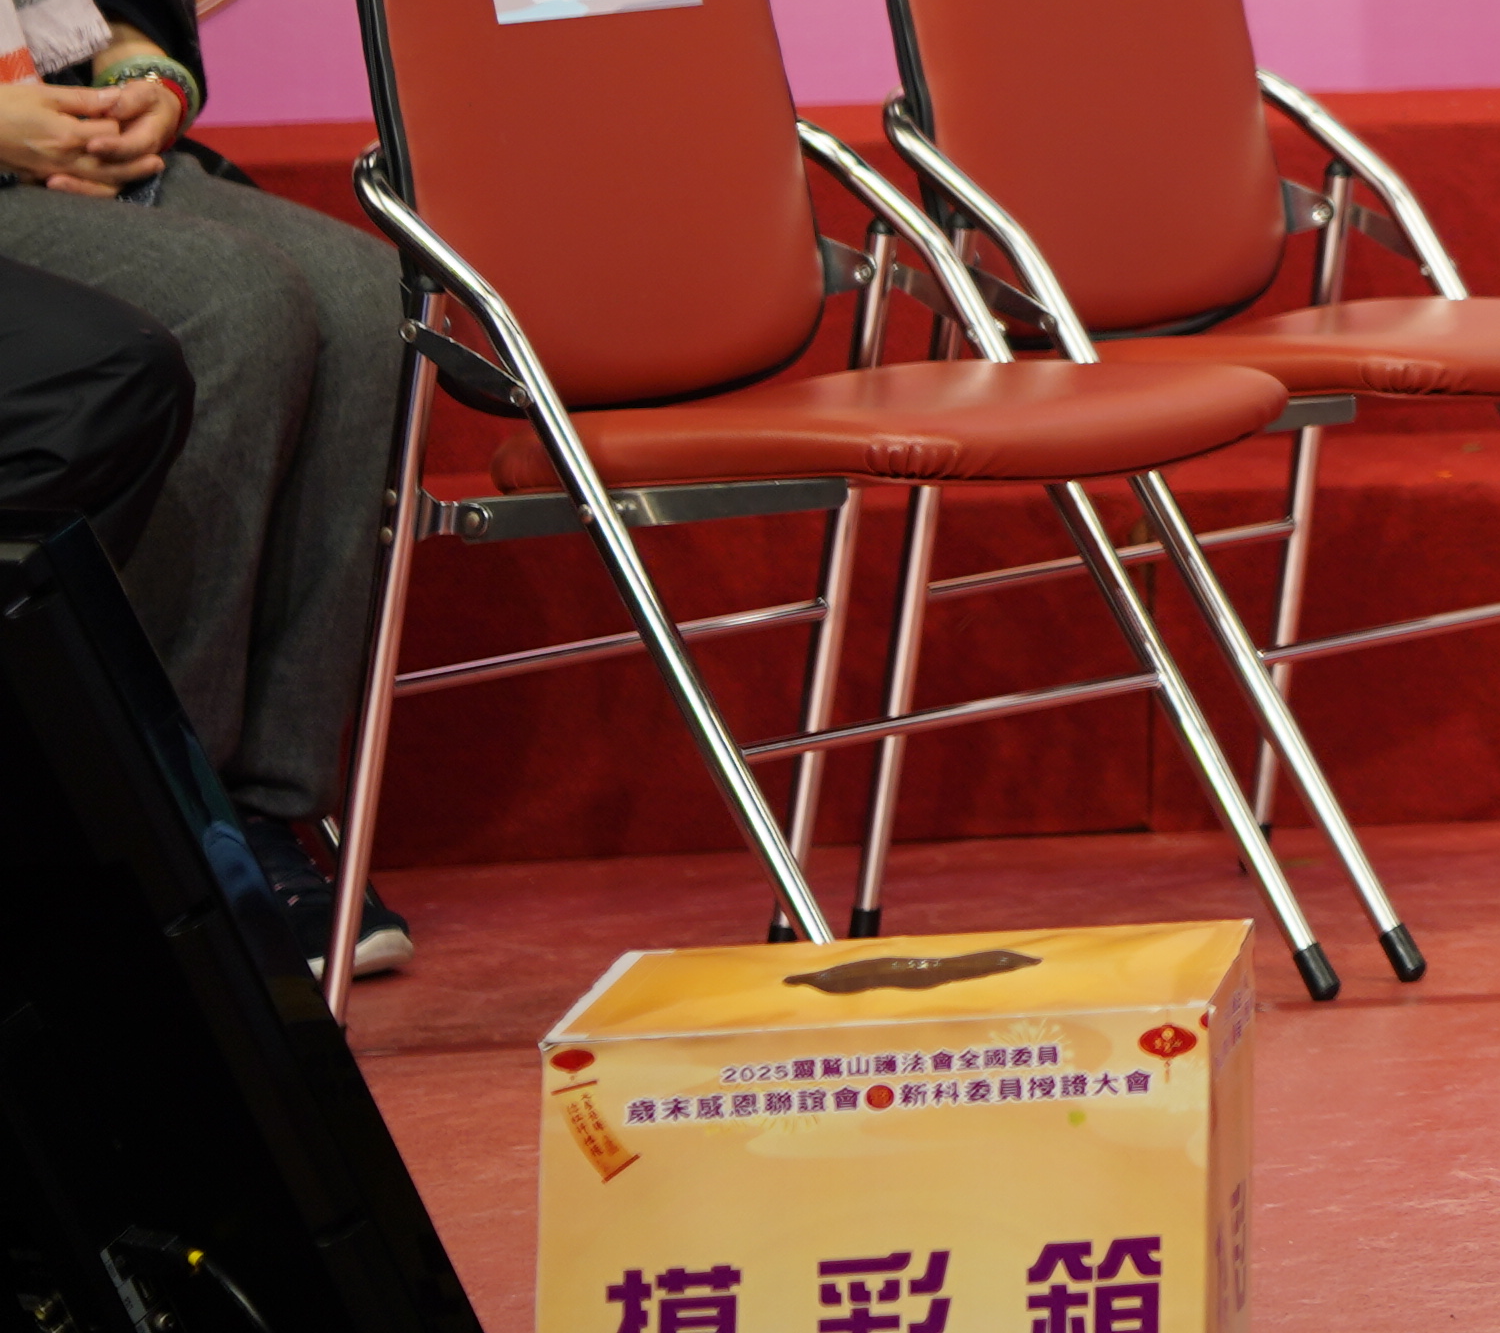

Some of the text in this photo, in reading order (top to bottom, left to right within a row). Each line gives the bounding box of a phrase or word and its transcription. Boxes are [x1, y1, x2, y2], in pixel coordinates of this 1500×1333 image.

[720, 1045, 1060, 1085] 2025靈鷲山護法會全國委員
